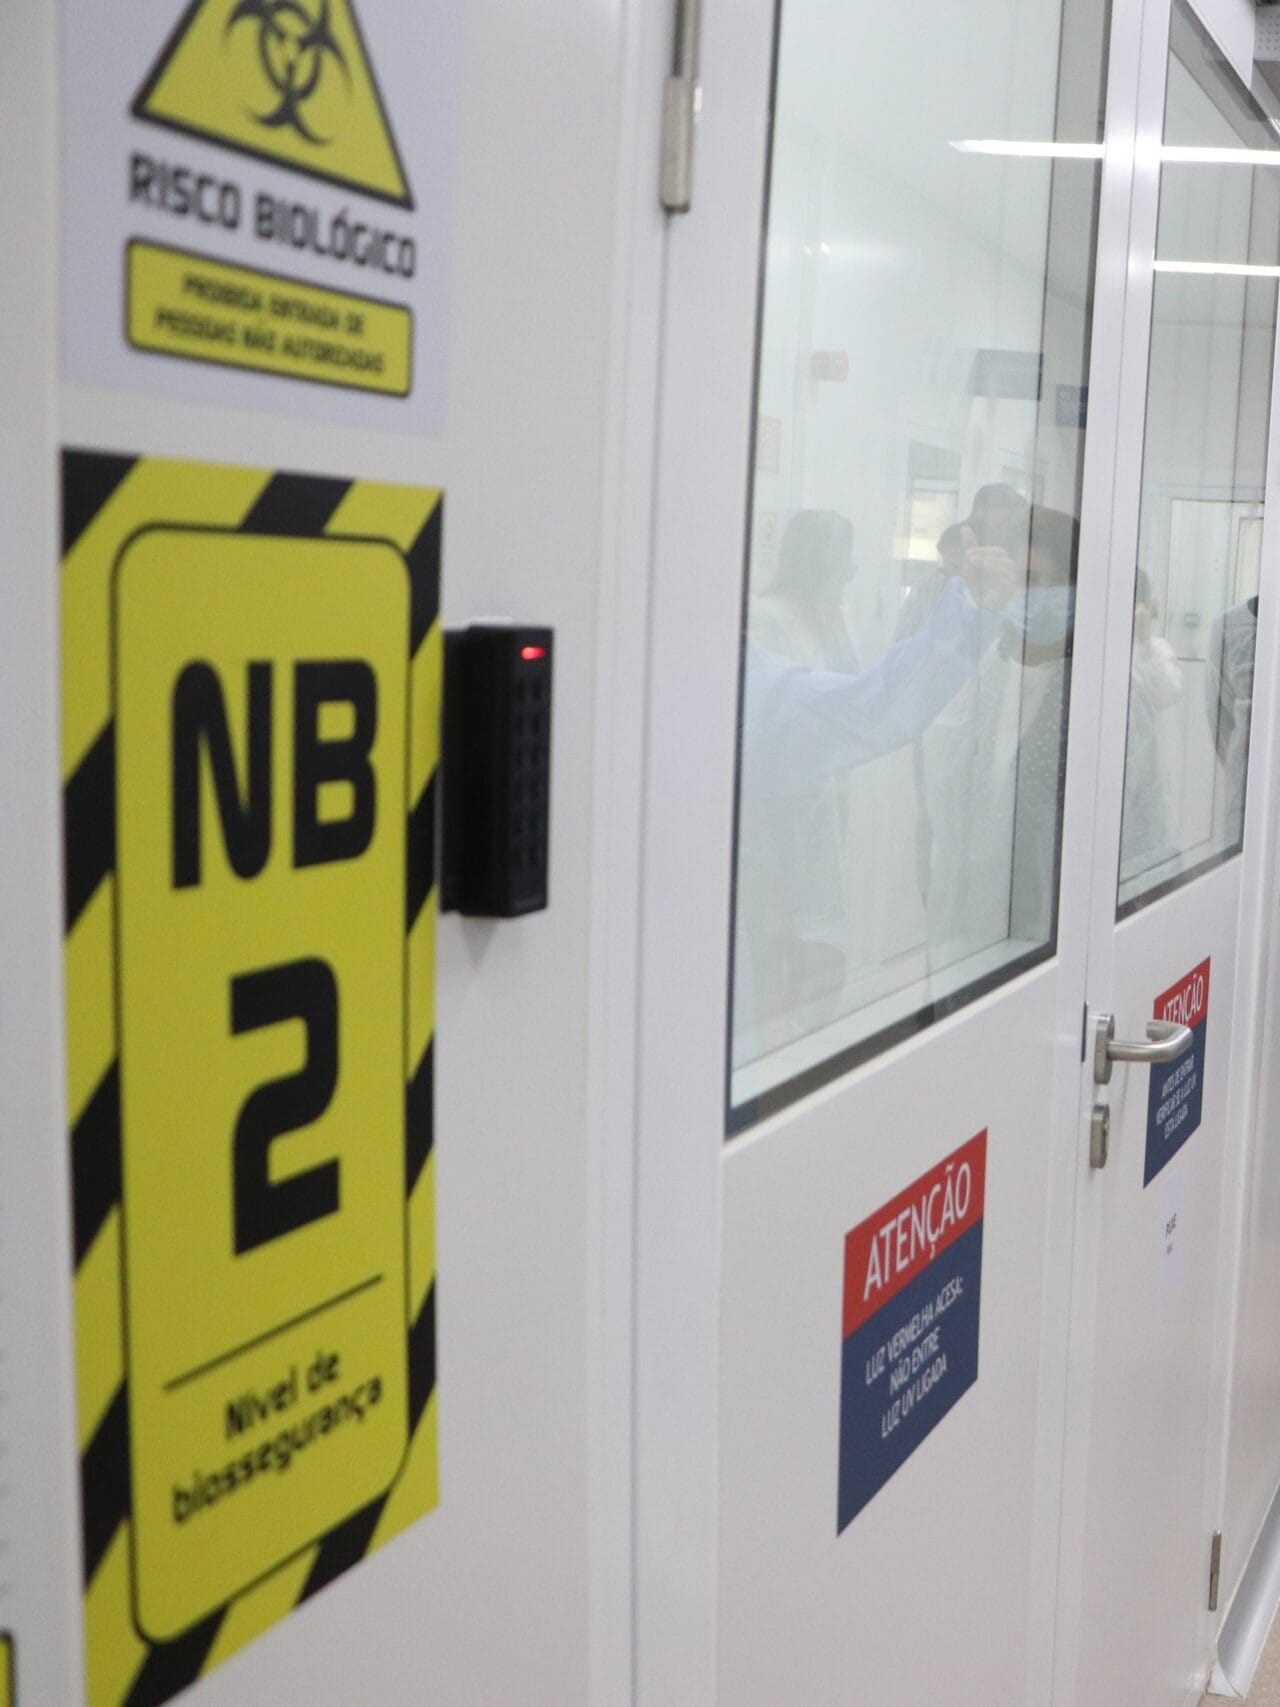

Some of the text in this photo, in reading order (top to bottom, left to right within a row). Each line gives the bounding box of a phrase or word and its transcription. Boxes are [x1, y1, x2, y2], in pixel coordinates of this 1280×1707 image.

[130, 151, 416, 278] RISCO BIOLÓGICO
[172, 656, 379, 891] NB
[228, 955, 341, 1258] 2
[863, 1161, 971, 1301] ATENÇÃO
[306, 1351, 339, 1393] de
[865, 1345, 886, 1385] LUZ
[887, 1302, 934, 1362] VERMELHA
[881, 1352, 948, 1439] LUZ UV LIGADA
[889, 1325, 941, 1396] NÃO ENTRE
[172, 1377, 382, 1524] biossegurança
